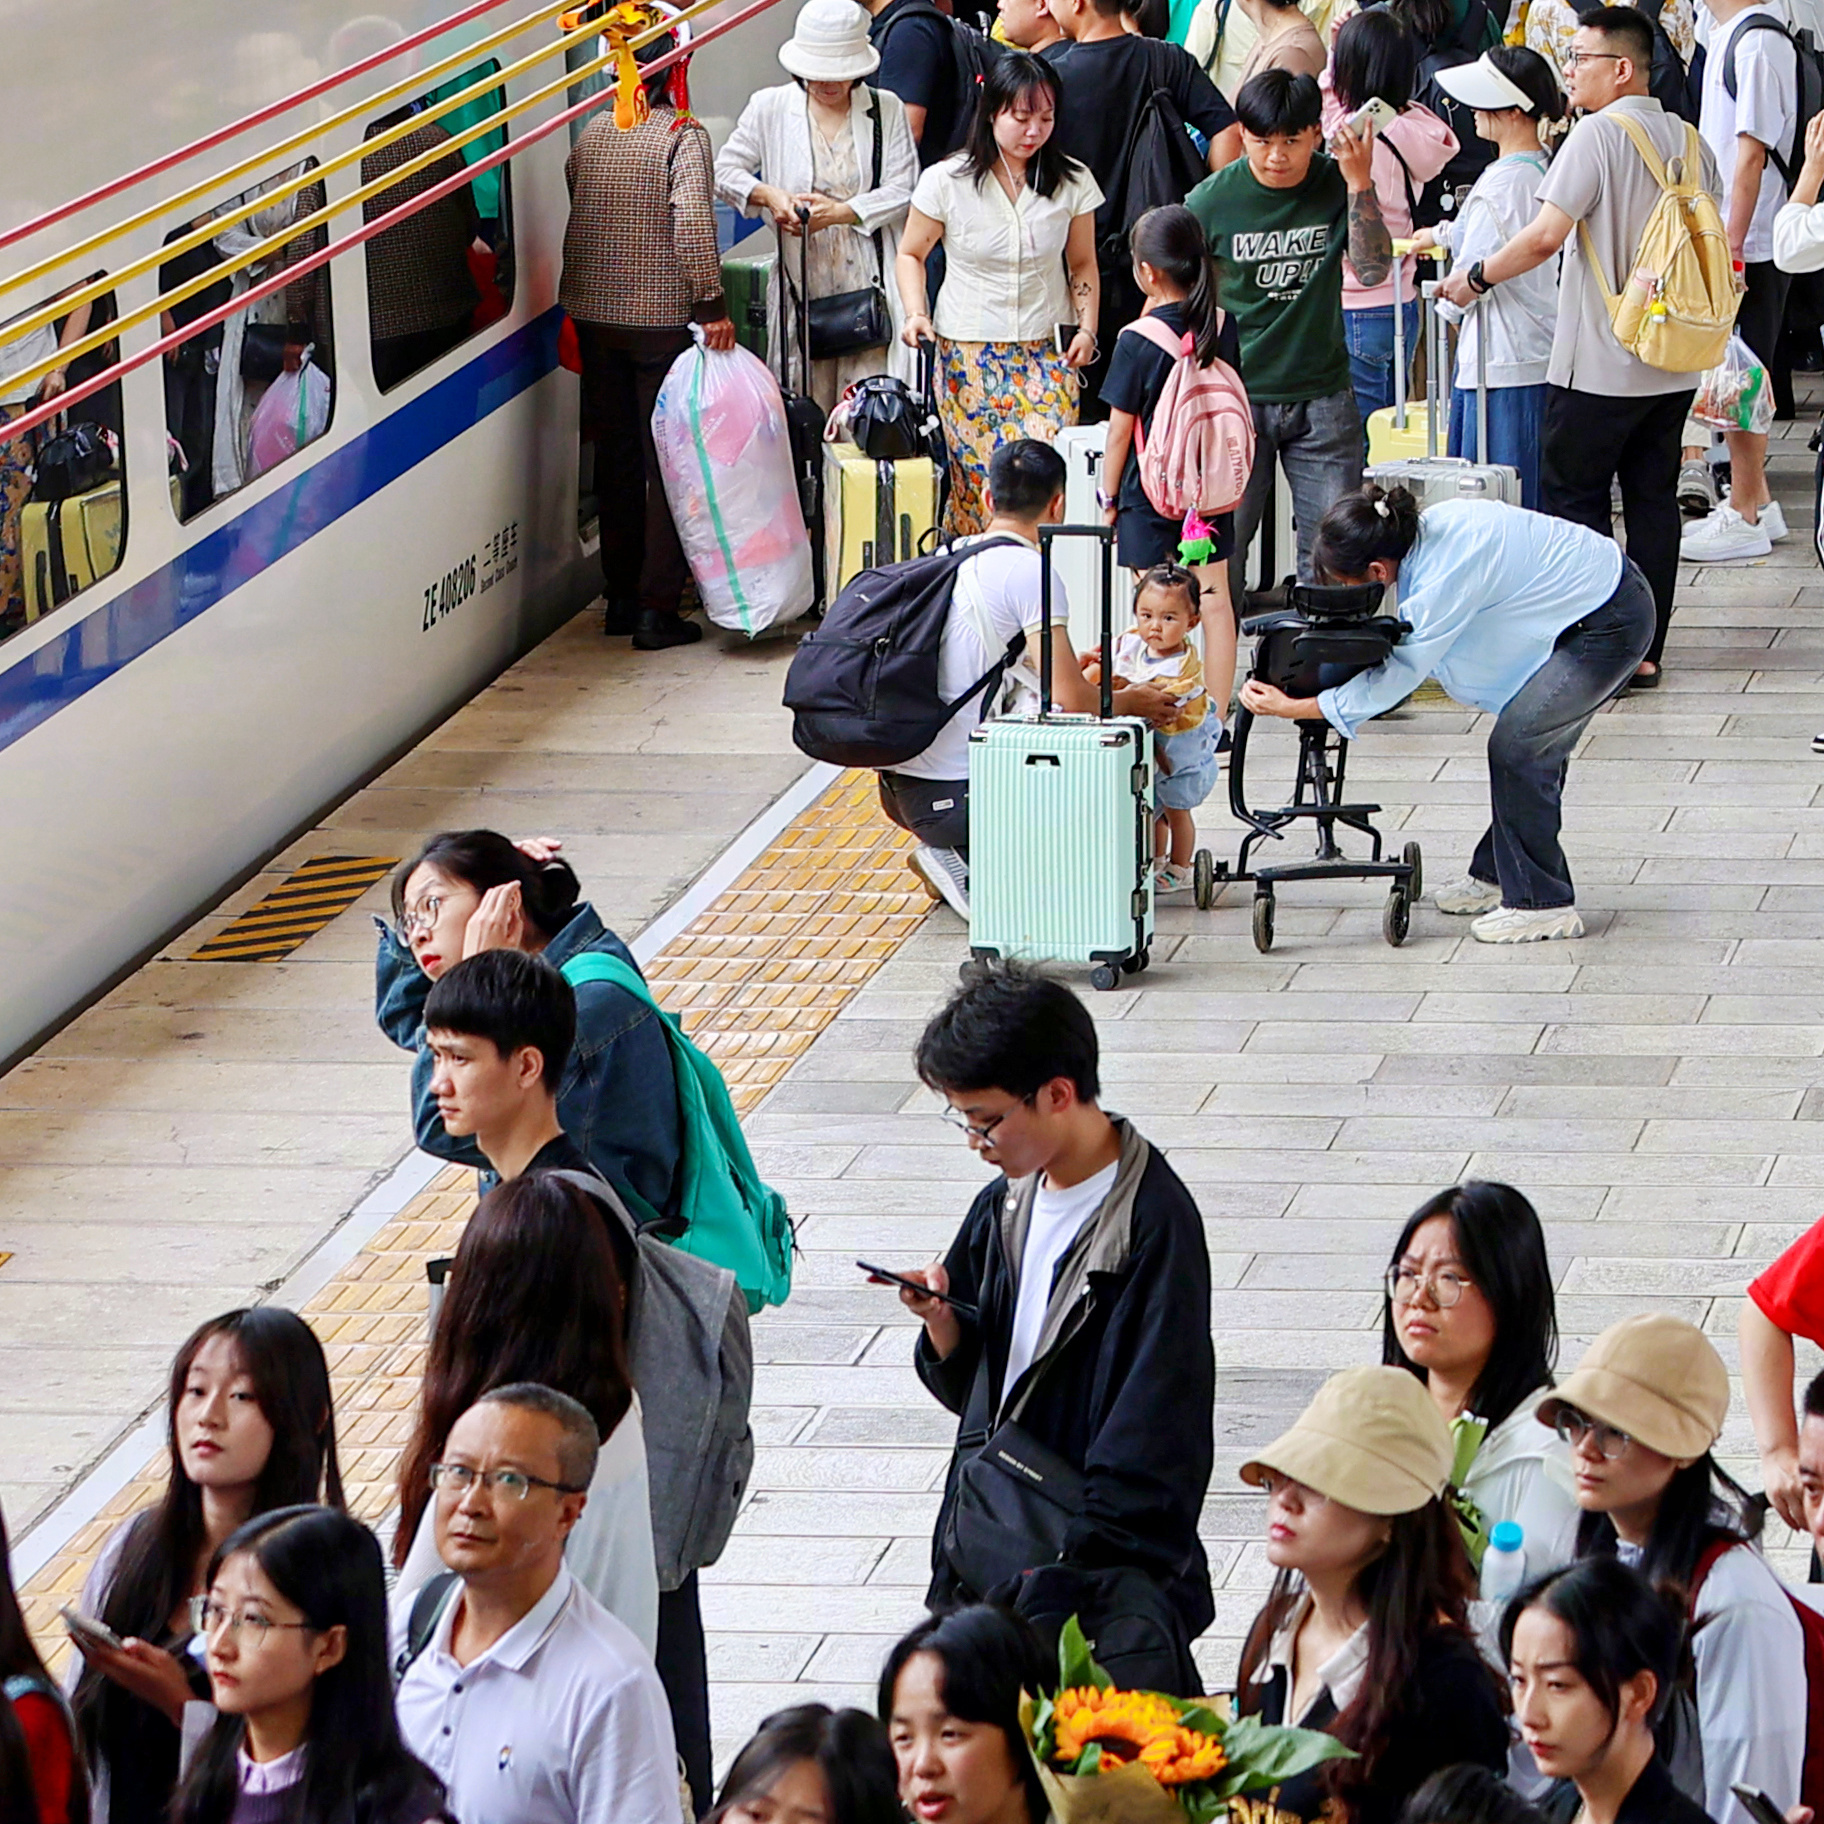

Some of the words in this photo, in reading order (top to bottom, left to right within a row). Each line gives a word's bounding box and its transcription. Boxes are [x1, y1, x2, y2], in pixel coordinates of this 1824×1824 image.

[1231, 225, 1328, 262] WAKE
[422, 583, 438, 633] ZE
[438, 553, 476, 619] 408206
